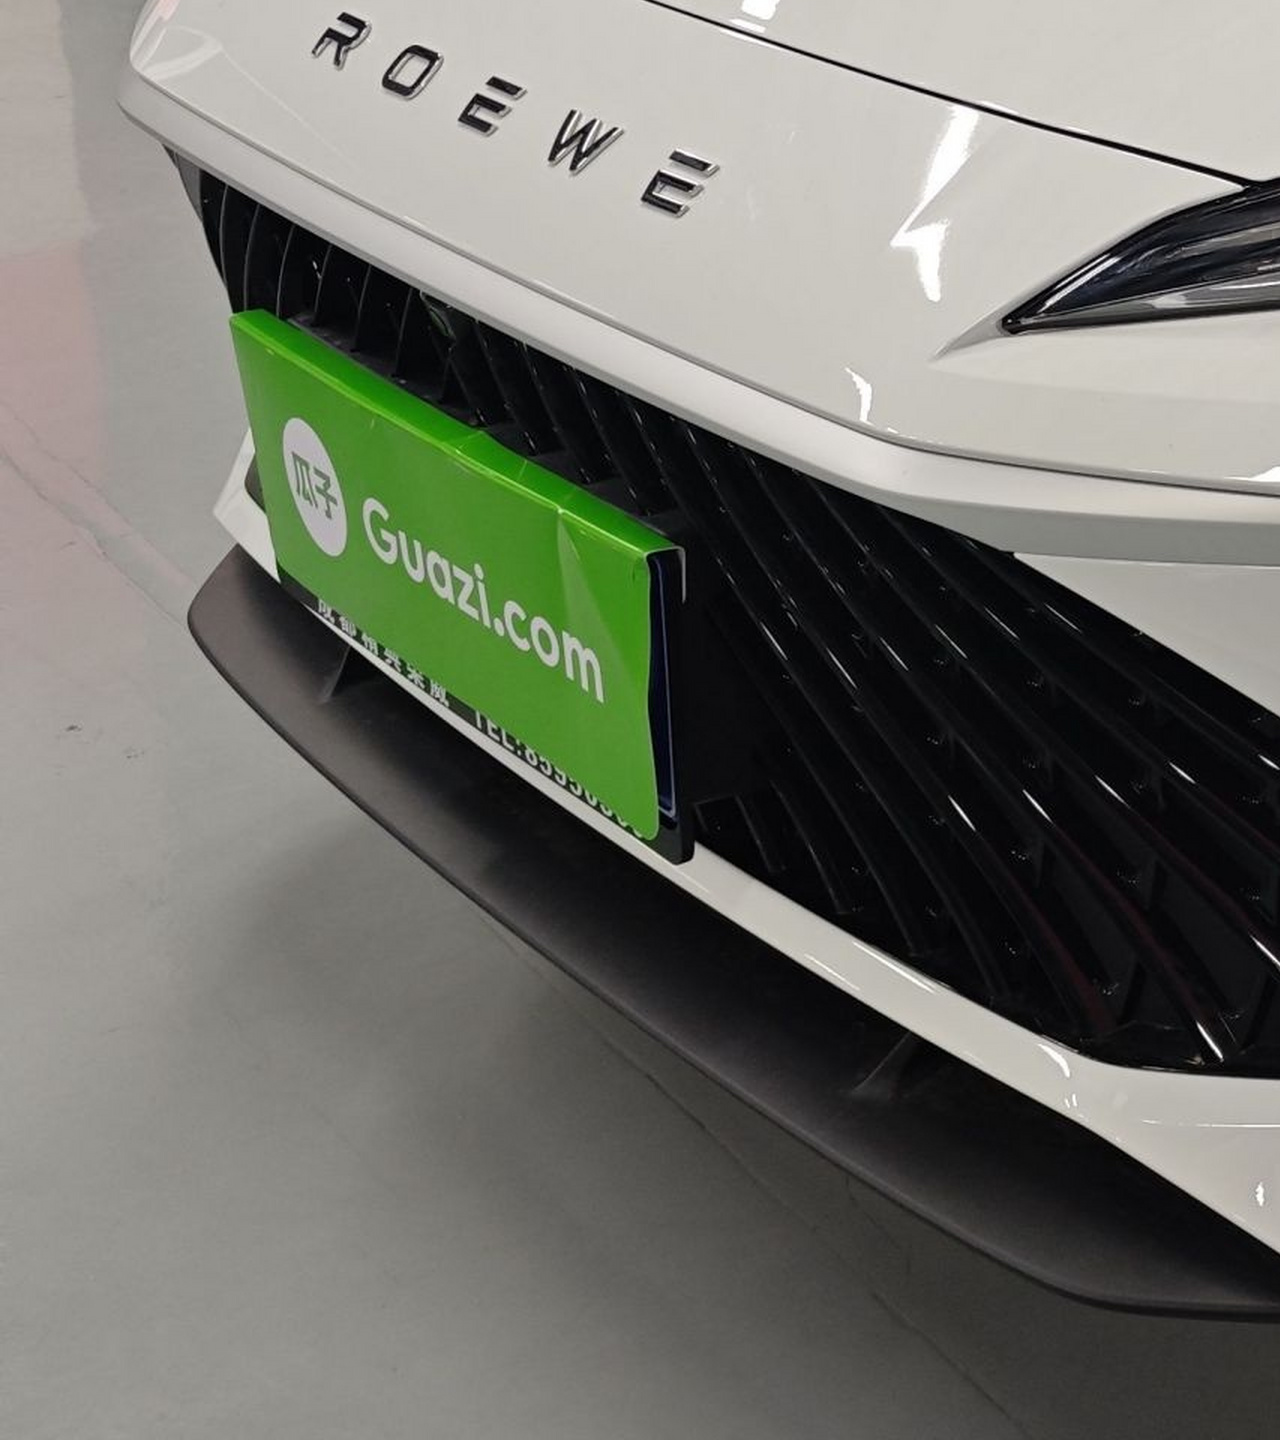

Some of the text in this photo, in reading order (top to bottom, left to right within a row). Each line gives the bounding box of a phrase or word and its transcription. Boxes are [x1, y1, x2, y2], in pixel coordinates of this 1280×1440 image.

[311, 11, 720, 218] ROEWE
[291, 451, 338, 520] 瓜子
[362, 497, 605, 703] Guazi.com
